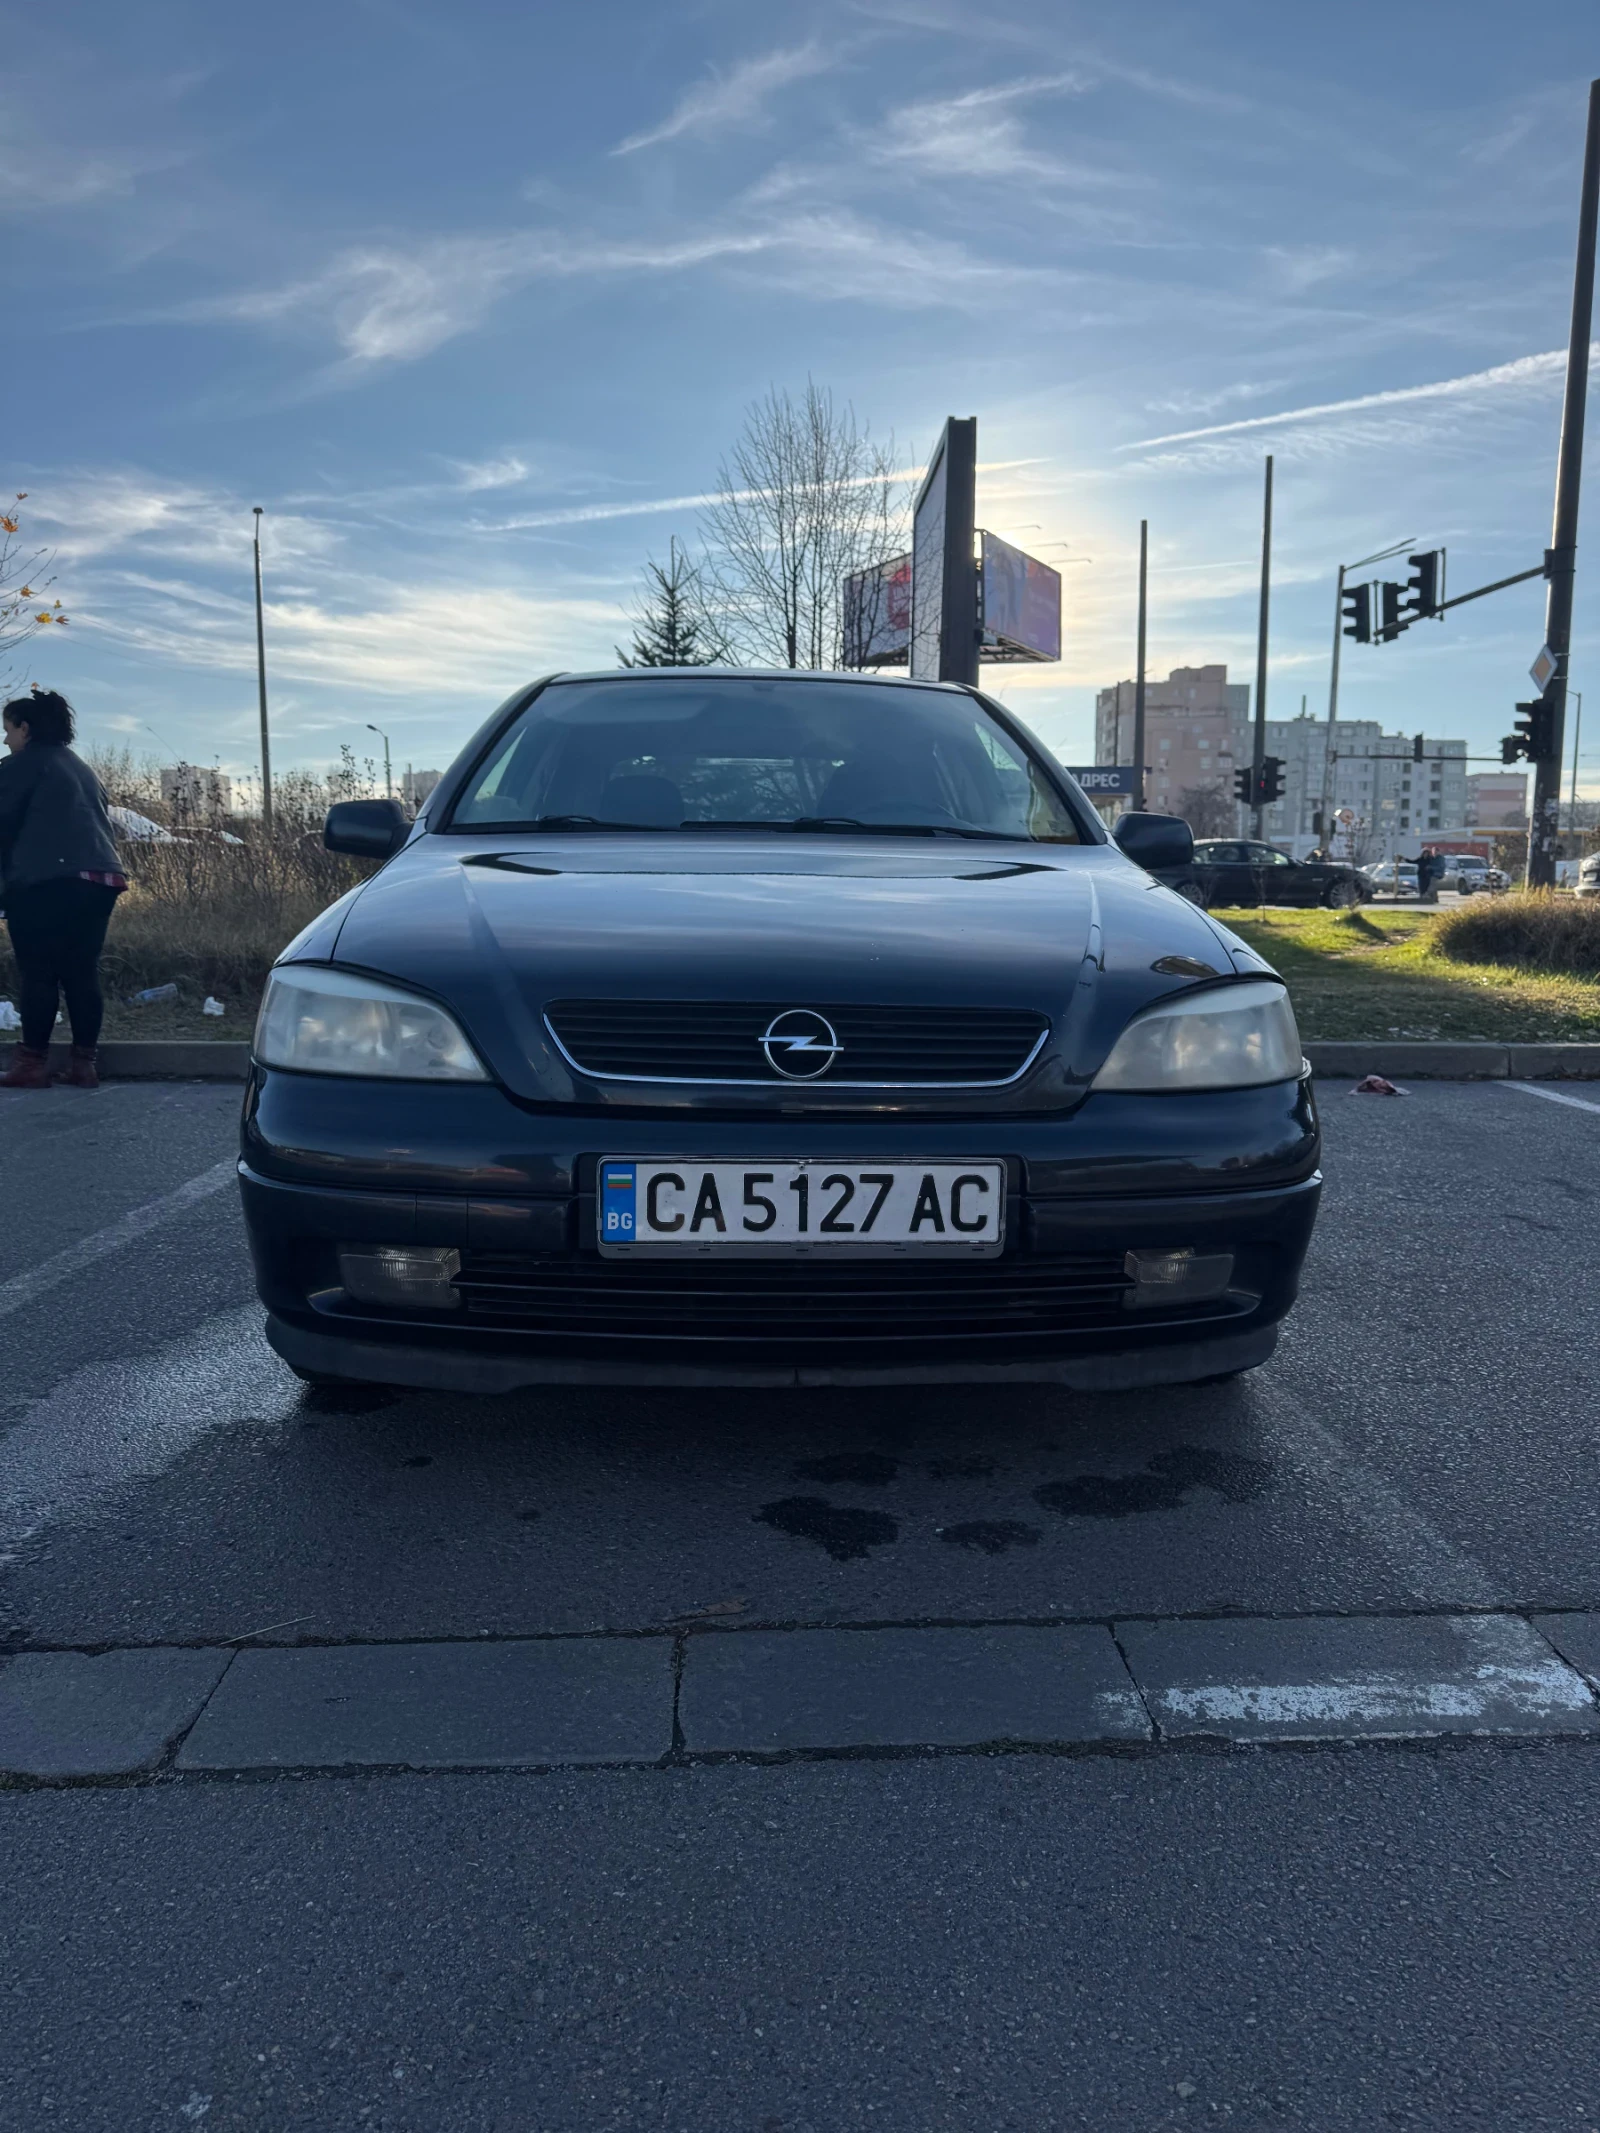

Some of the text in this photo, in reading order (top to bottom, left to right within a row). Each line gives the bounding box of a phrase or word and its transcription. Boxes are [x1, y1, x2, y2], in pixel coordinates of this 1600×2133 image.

[607, 1212, 633, 1230] BG
[743, 1173, 895, 1233] 5127
[908, 1172, 990, 1233] AC
